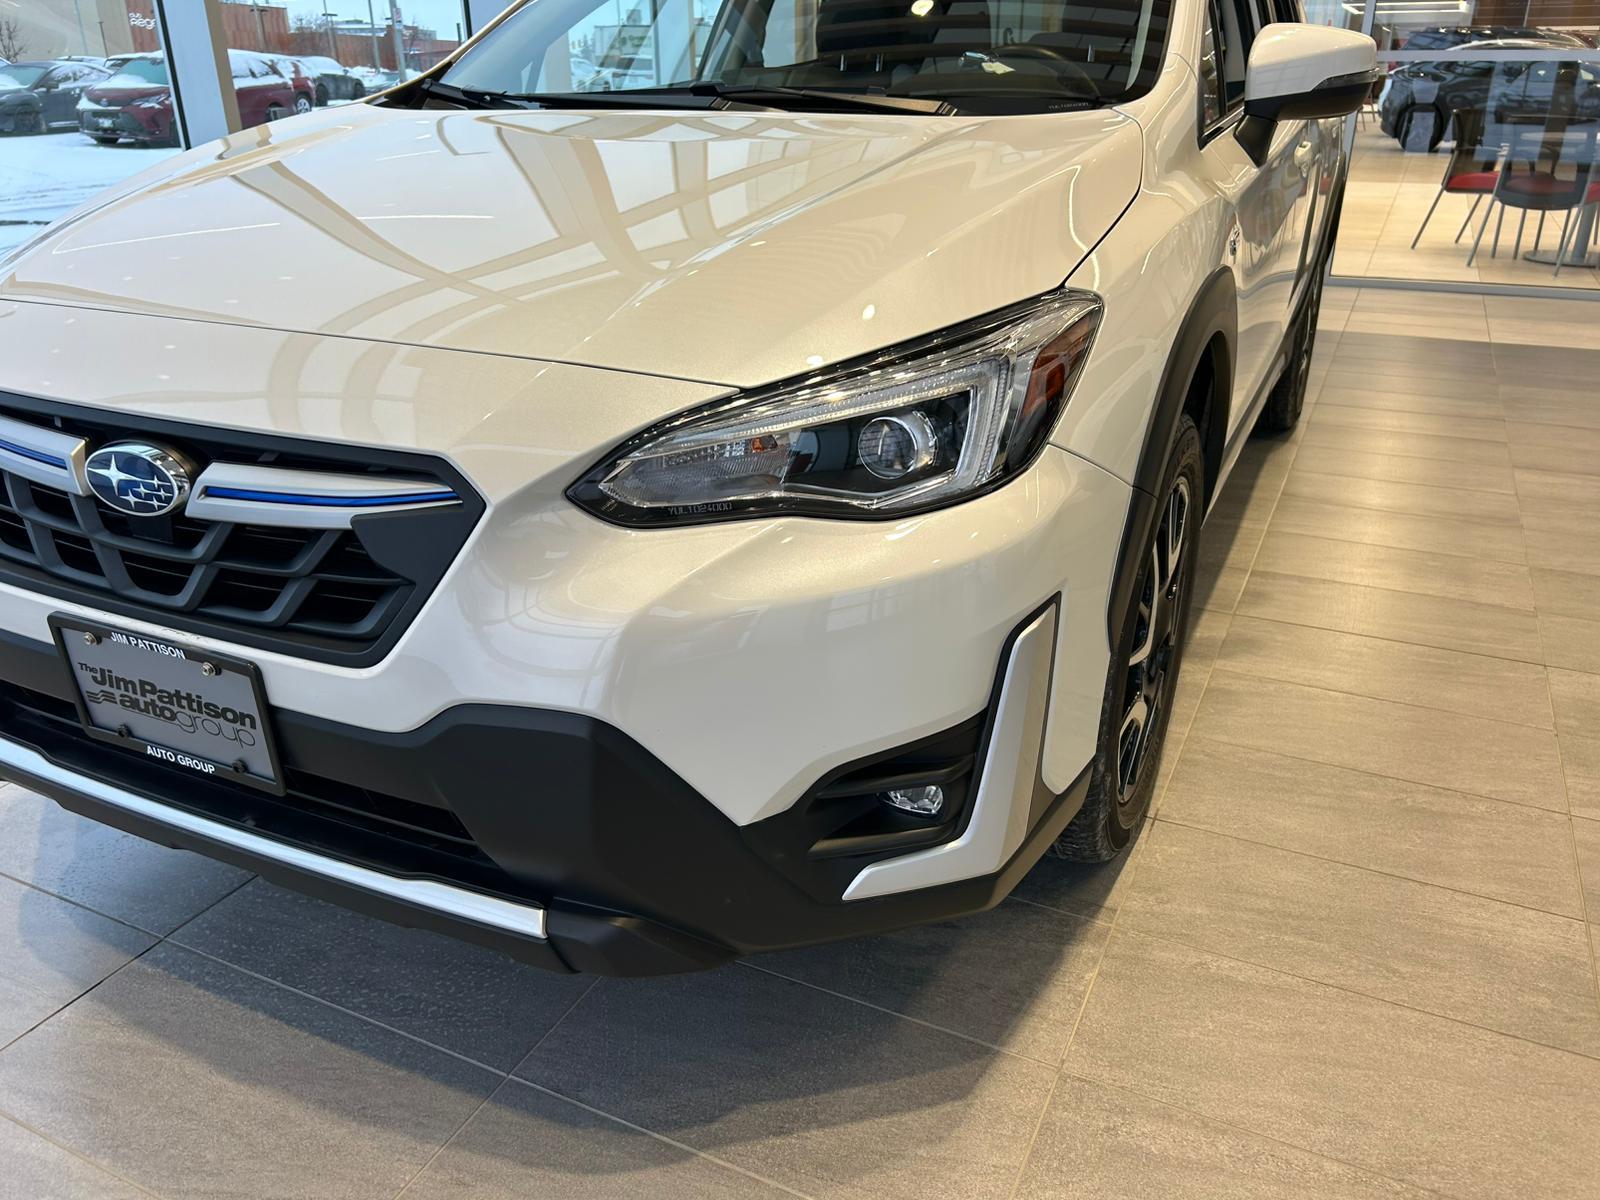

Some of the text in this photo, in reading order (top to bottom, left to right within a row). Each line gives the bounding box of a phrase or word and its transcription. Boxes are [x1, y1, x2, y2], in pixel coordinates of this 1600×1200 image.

[111, 631, 186, 660] JIM PATTISON
[78, 662, 98, 674] The
[147, 745, 216, 774] AUTO GROUP
